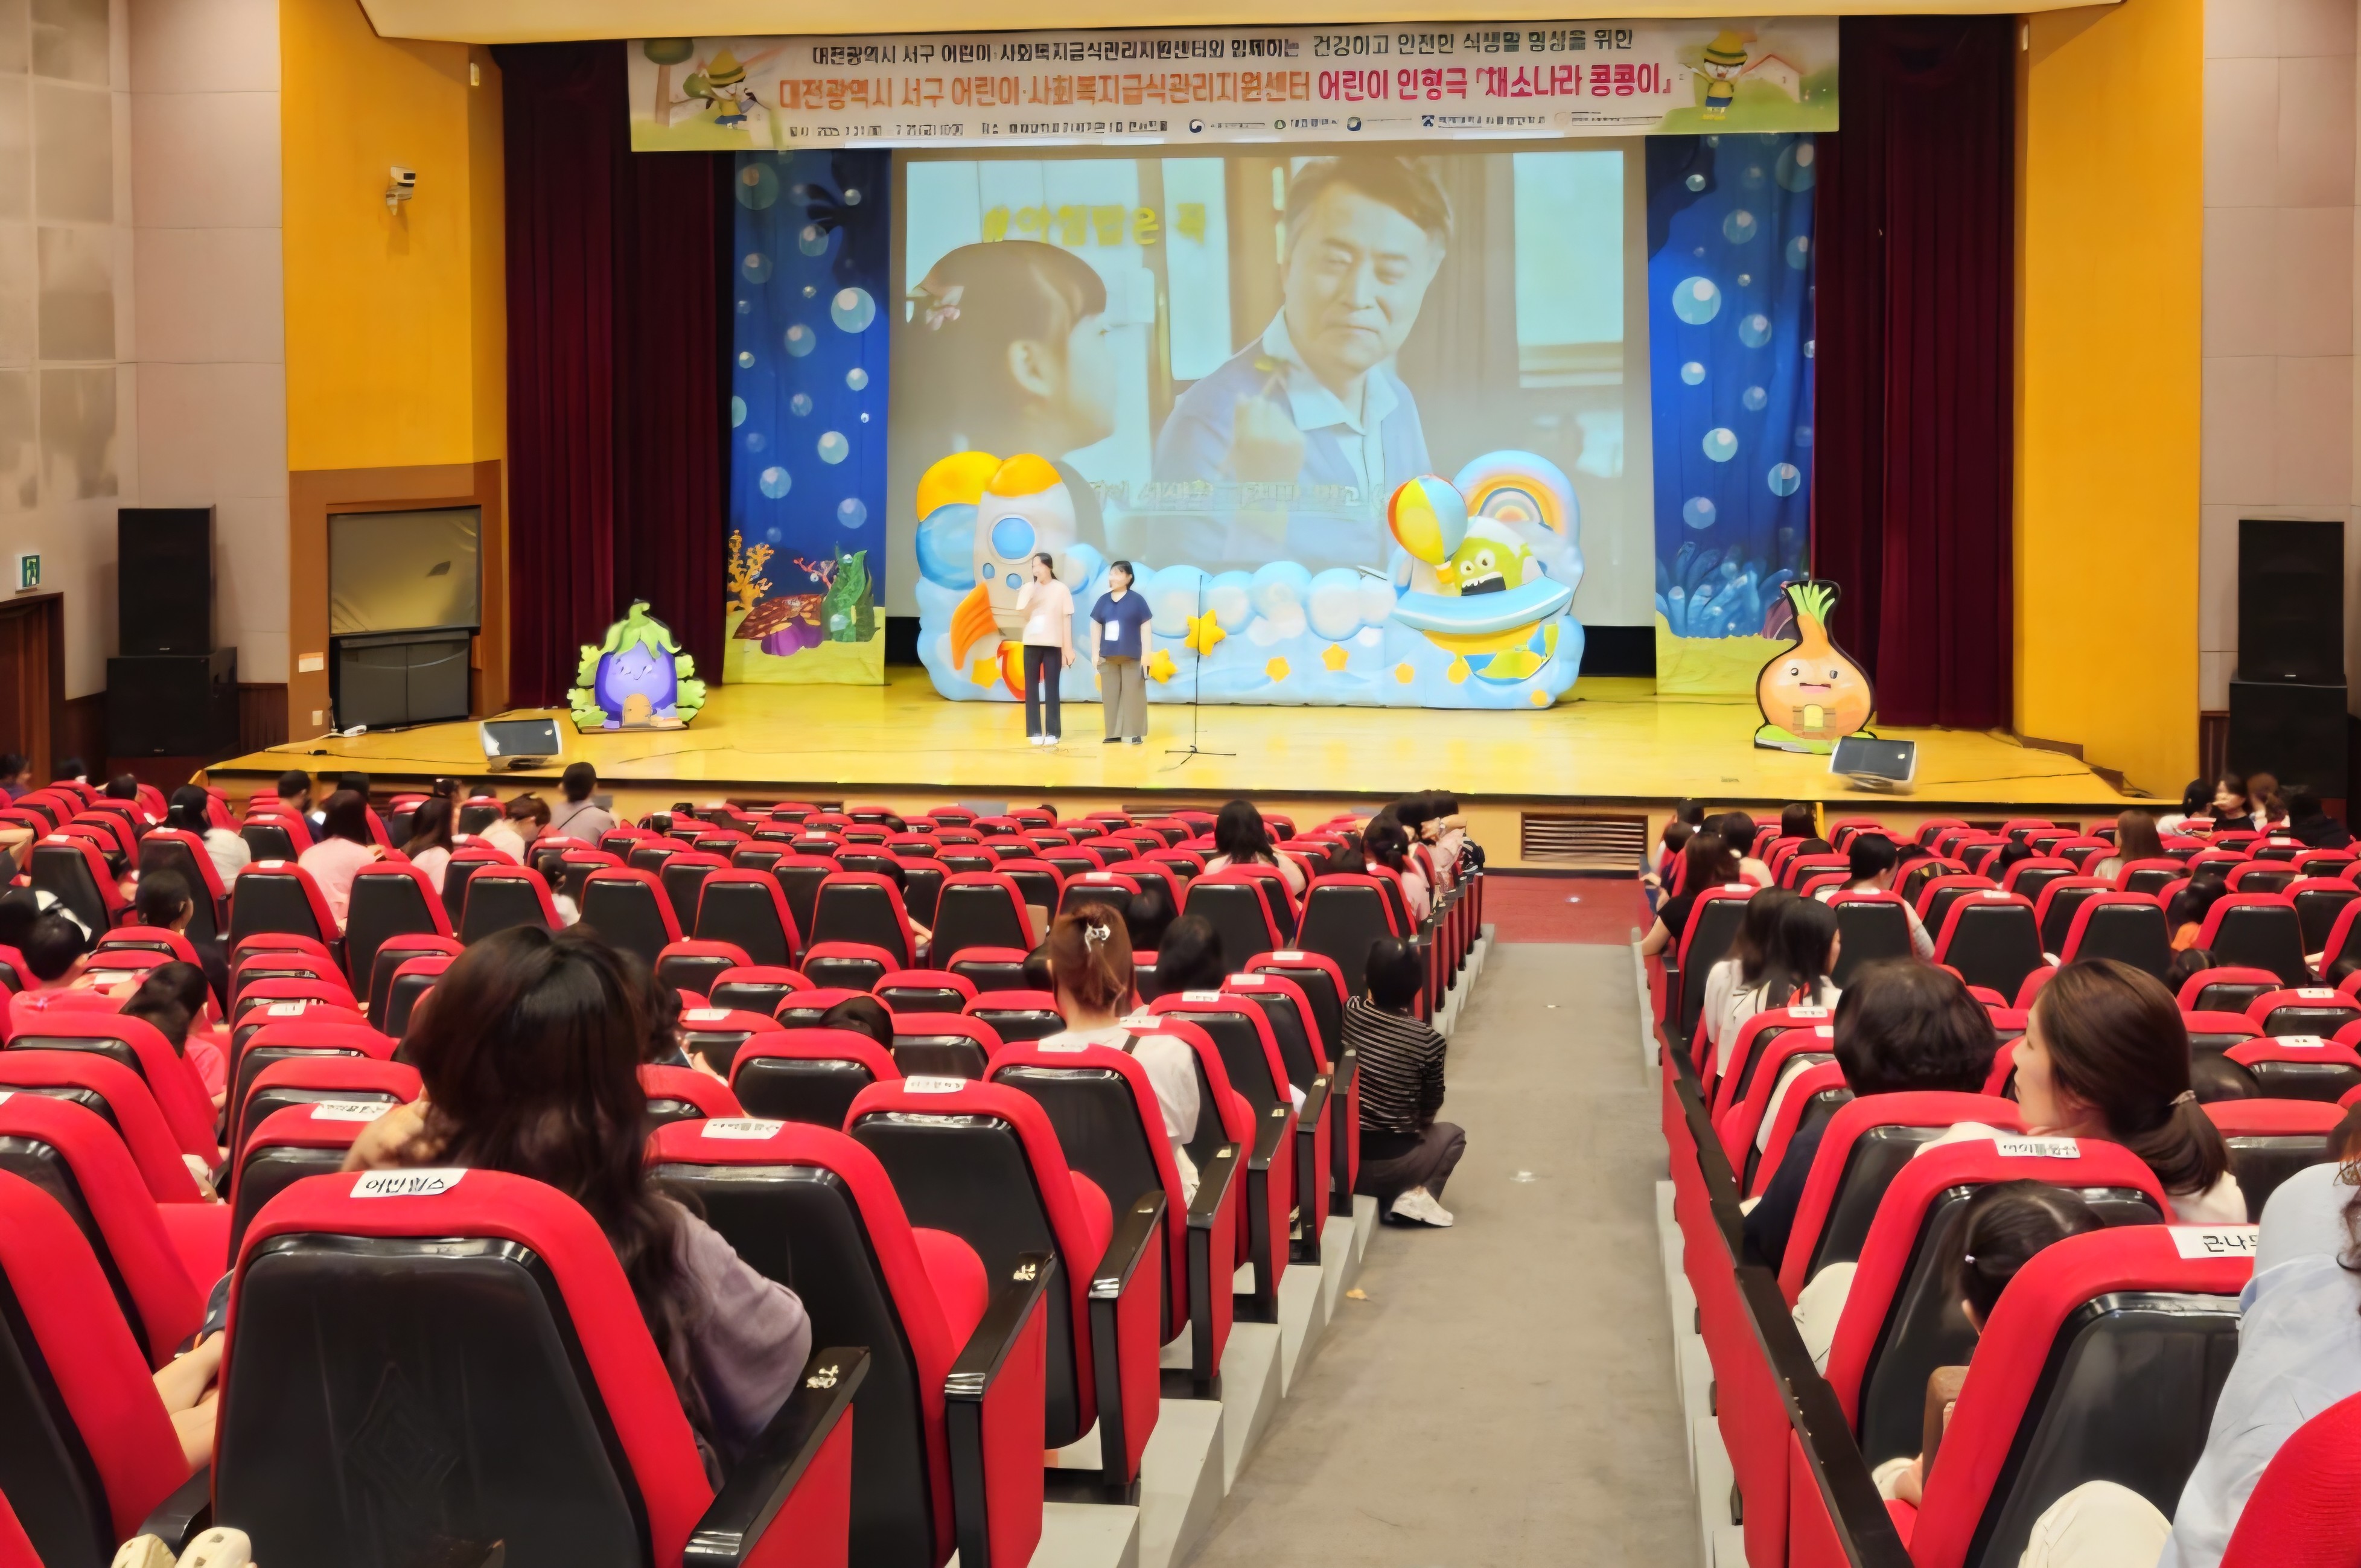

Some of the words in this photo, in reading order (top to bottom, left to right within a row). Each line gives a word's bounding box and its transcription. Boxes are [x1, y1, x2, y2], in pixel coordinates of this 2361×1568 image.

[902, 45, 934, 64] 서구
[779, 77, 893, 110] 대전광역시
[901, 77, 945, 108] 서구
[1318, 69, 1389, 101] 어린이
[1397, 68, 1467, 101] 인형극
